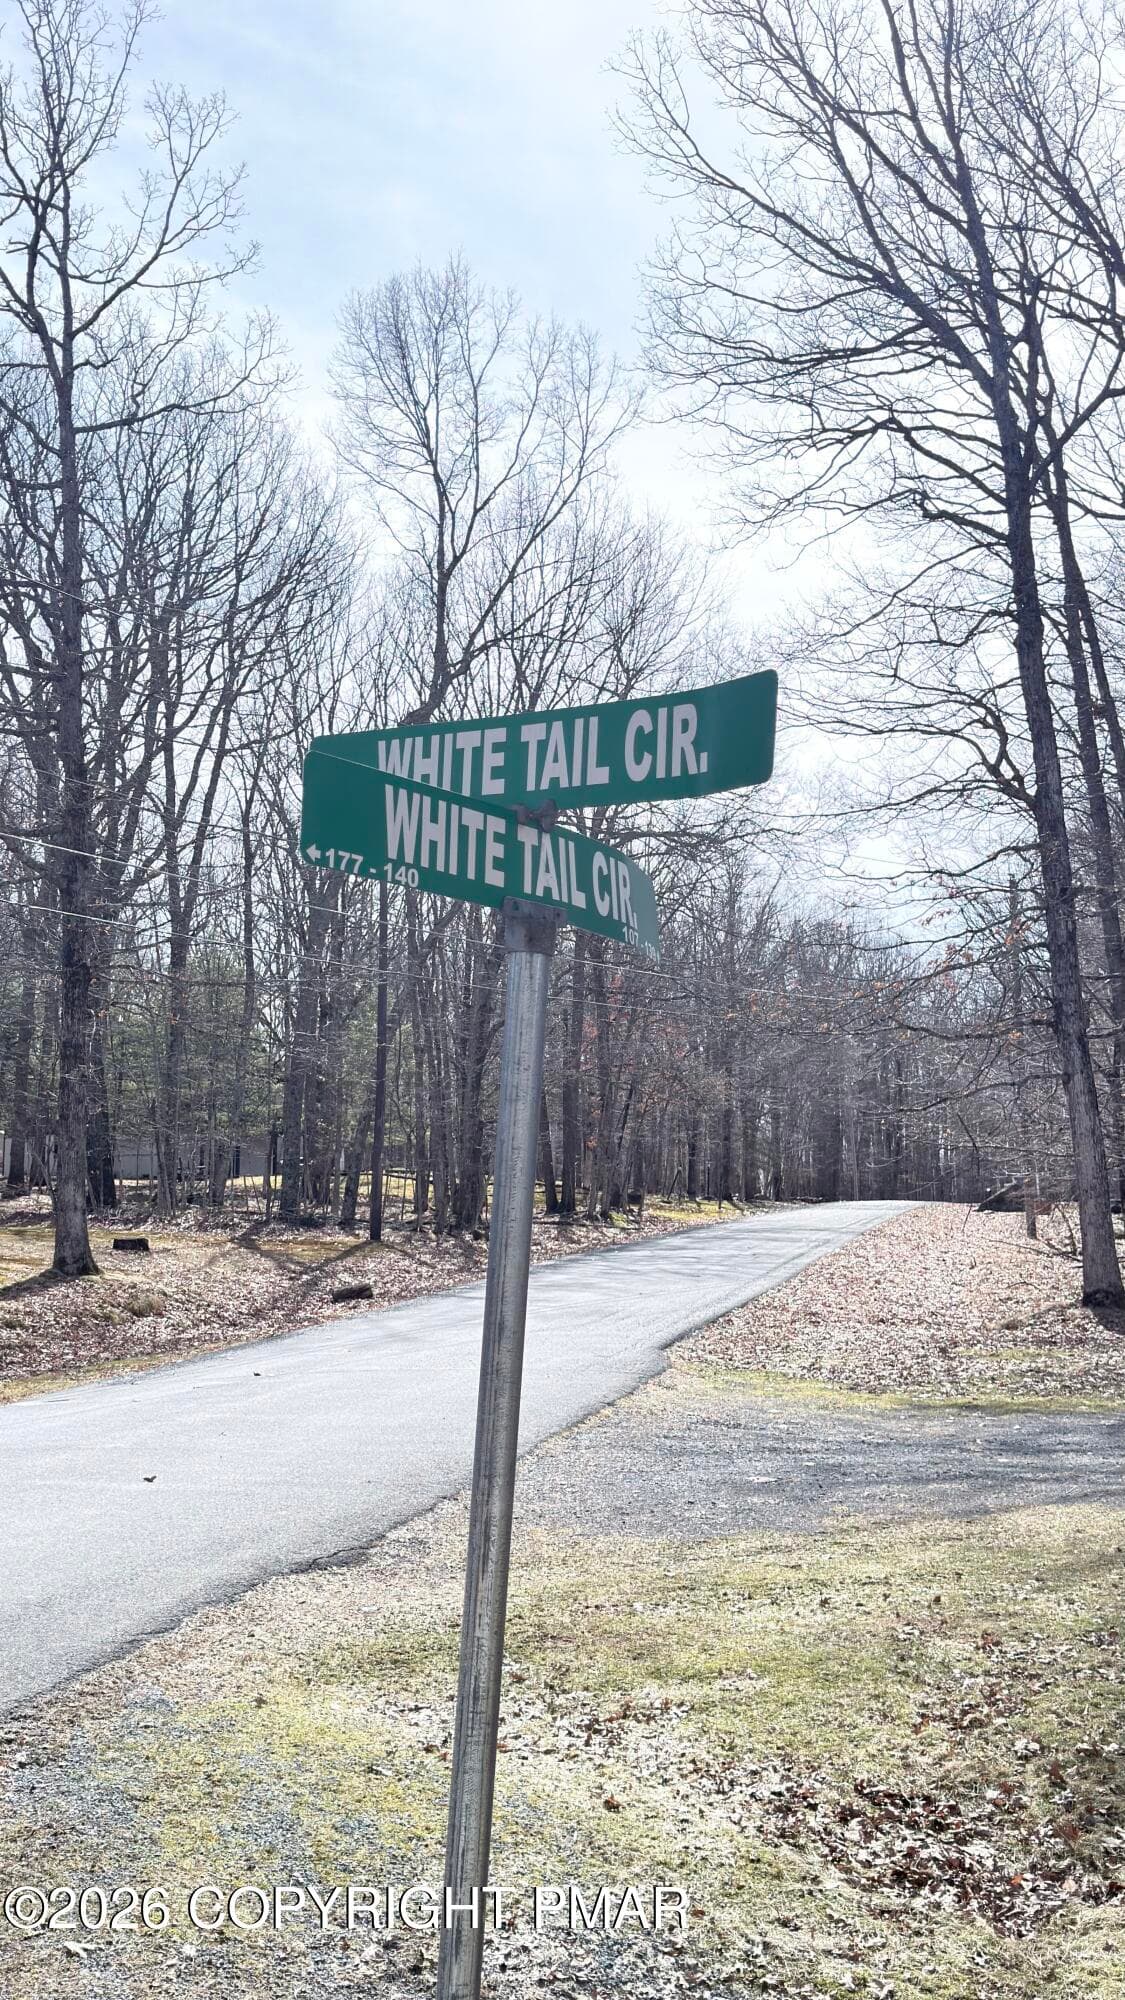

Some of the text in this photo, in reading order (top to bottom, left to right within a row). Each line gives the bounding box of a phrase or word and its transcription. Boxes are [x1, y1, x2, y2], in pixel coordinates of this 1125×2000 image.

[378, 703, 708, 796] WHITE TAIL CIR.
[325, 848, 364, 875] 177
[383, 862, 419, 888] 140
[385, 783, 638, 930] WHITE TAIL CIR.
[622, 926, 639, 947] 107
